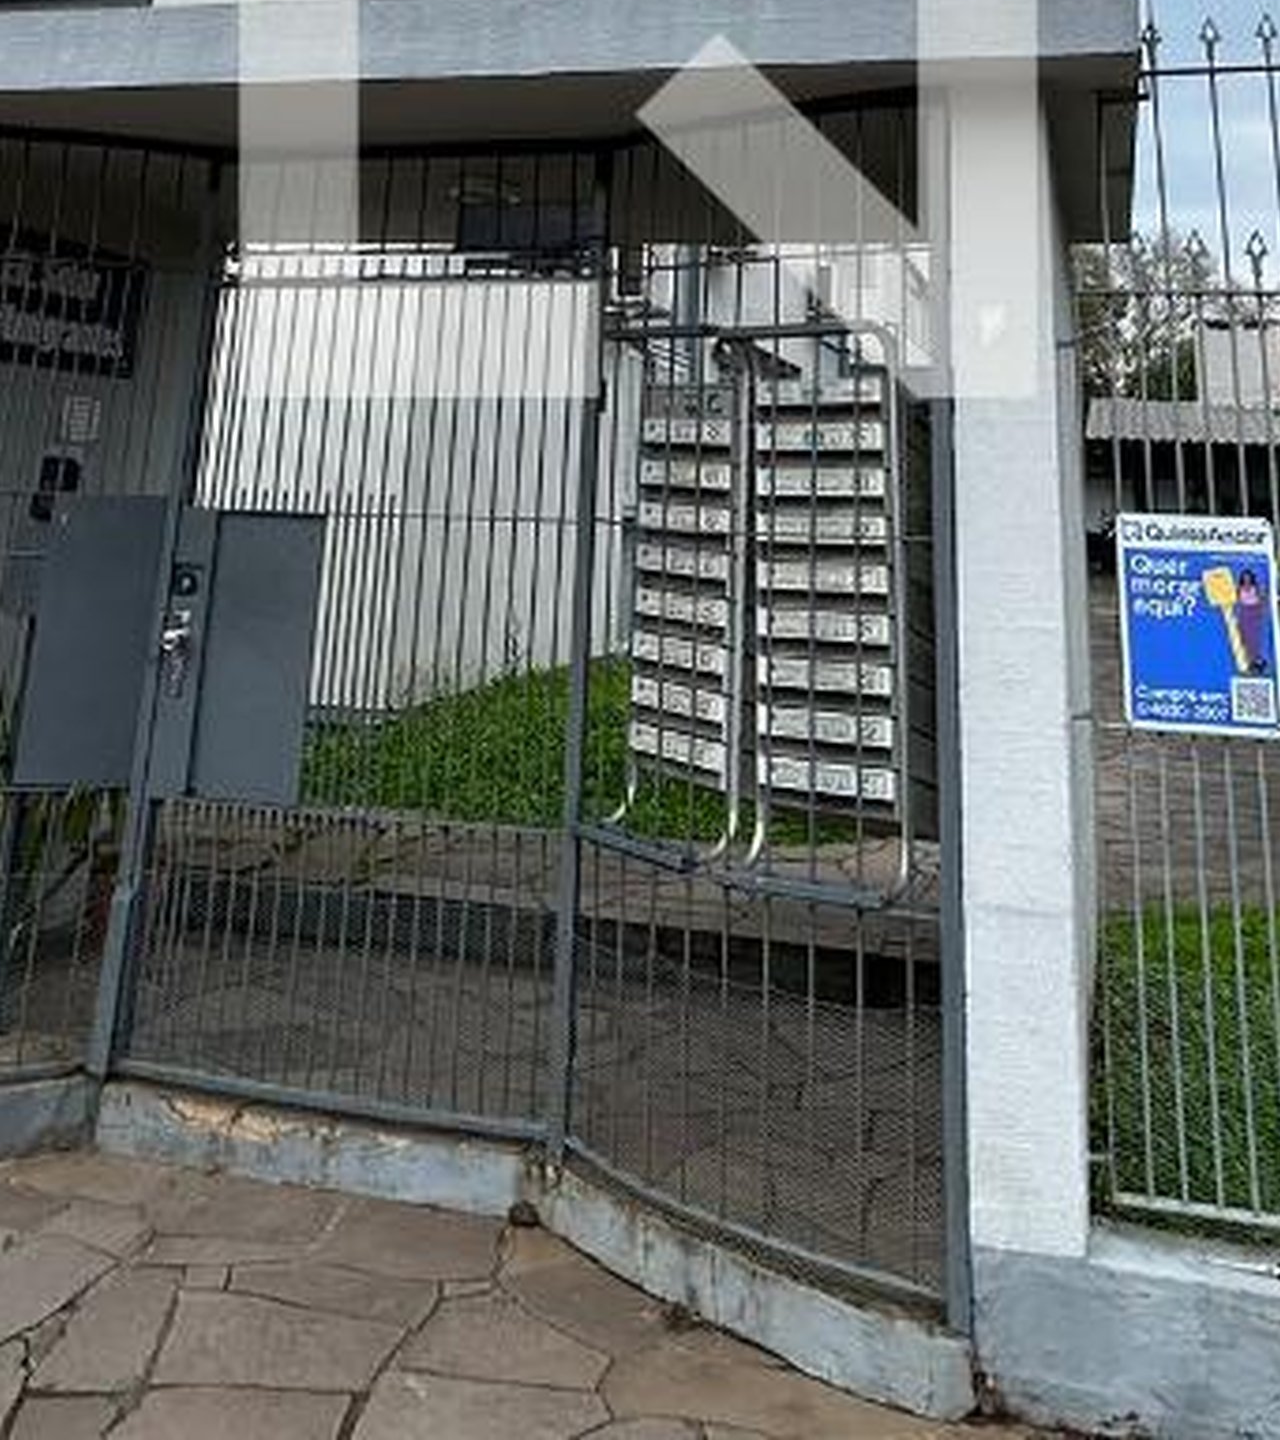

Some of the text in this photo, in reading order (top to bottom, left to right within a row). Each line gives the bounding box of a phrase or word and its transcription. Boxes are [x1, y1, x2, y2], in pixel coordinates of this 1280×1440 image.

[1130, 555, 1187, 574] Quer
[1131, 578, 1201, 596] morar
[1132, 595, 1196, 619] aqui?
